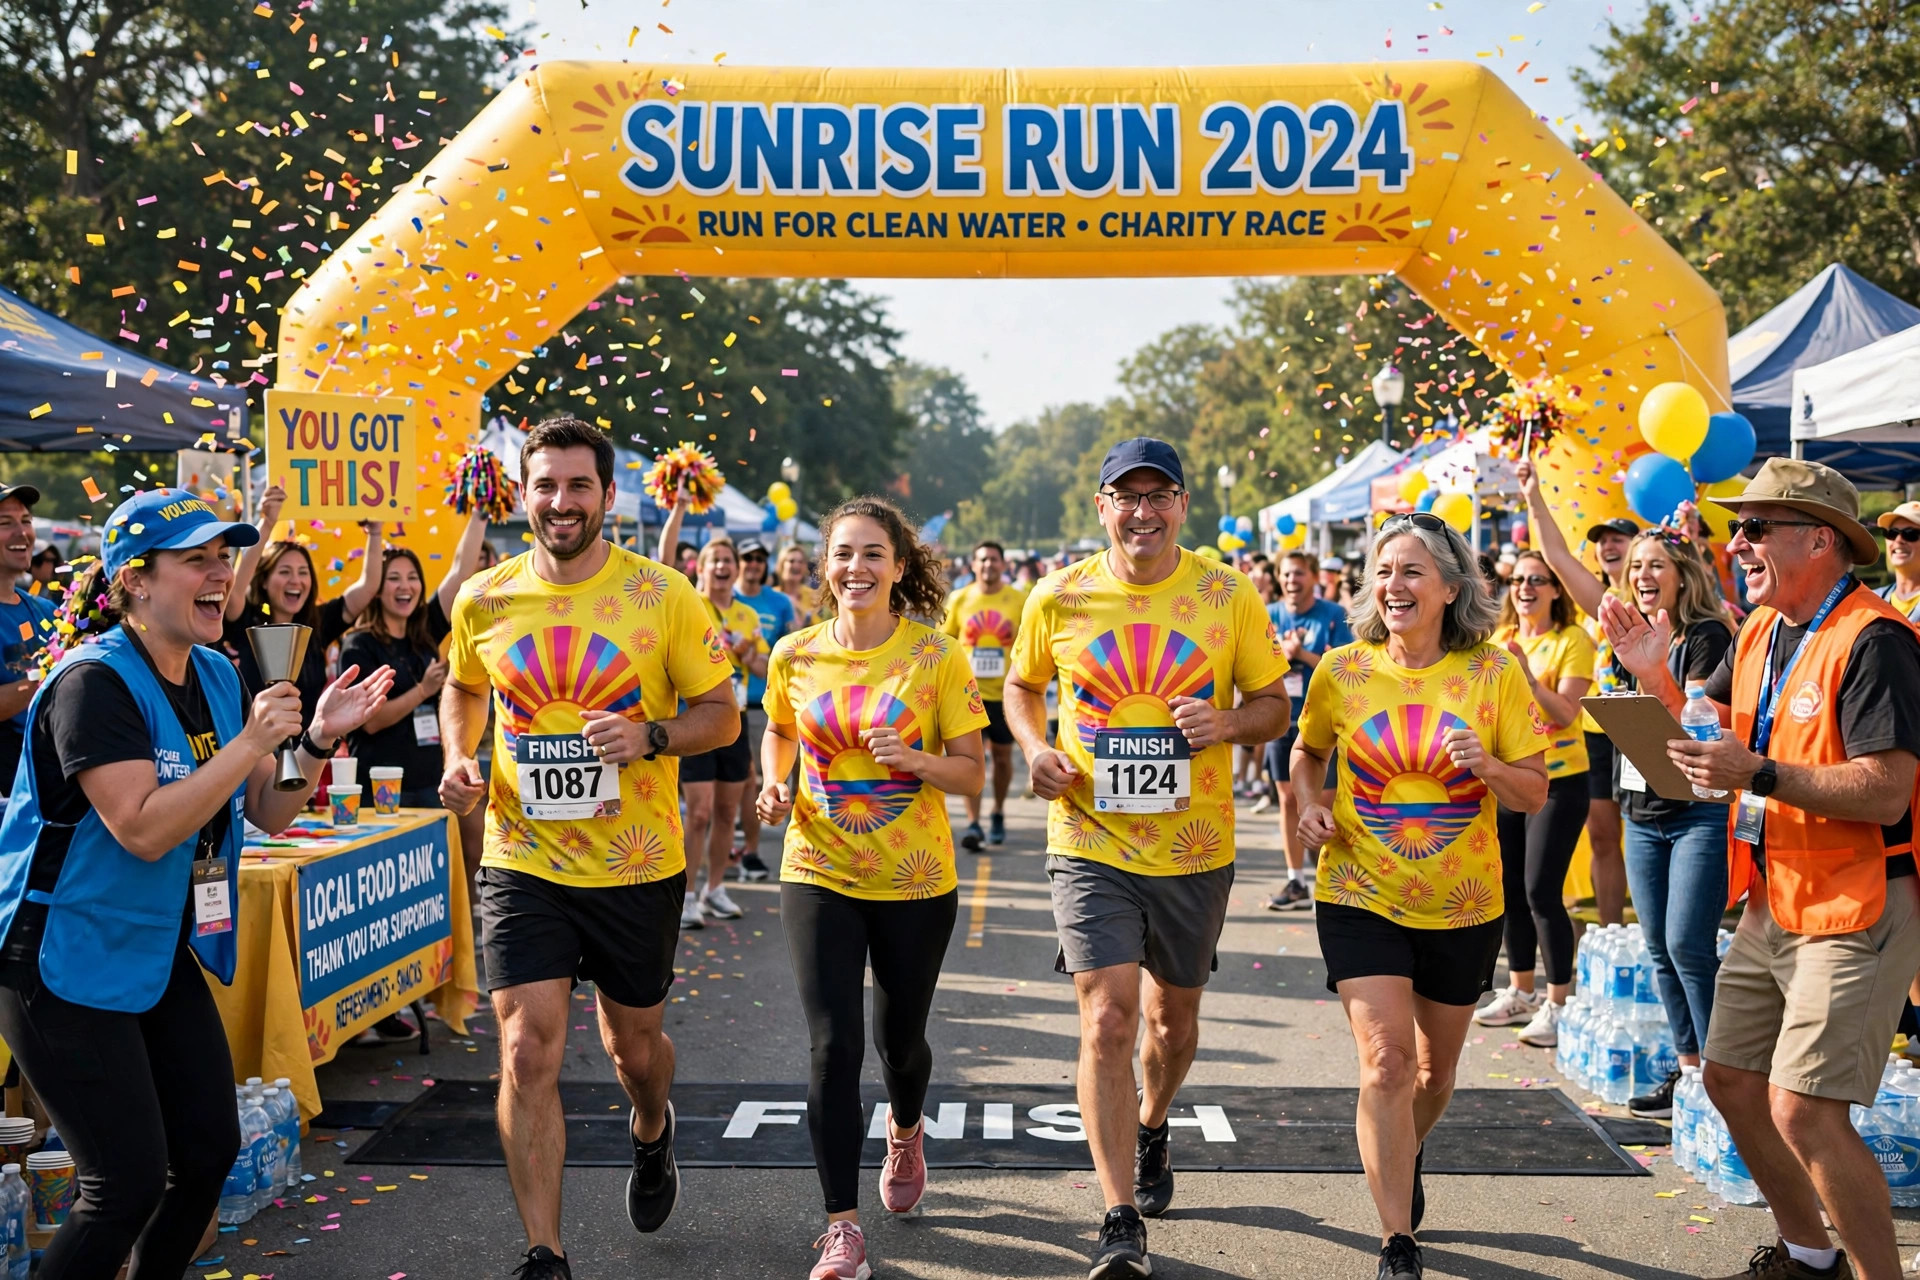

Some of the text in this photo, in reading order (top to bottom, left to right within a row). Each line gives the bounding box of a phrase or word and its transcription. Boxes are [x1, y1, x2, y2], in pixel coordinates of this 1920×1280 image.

[620, 99, 1415, 197] SUNRISE RUN 2024
[698, 209, 1327, 239] RUN FOR CLEAN WATER CHARITY RACE
[279, 408, 405, 453] YOU GOT
[290, 459, 400, 508] THIS!
[528, 739, 597, 760] FINISH
[1108, 737, 1174, 756] FINISH
[529, 765, 603, 800] 1087
[1107, 763, 1178, 795] 1124
[306, 842, 435, 931] LOCAL FOOD BANK
[306, 892, 445, 983] THANK YOU FOR SUPPORTING
[721, 1100, 1237, 1143] FNISH
